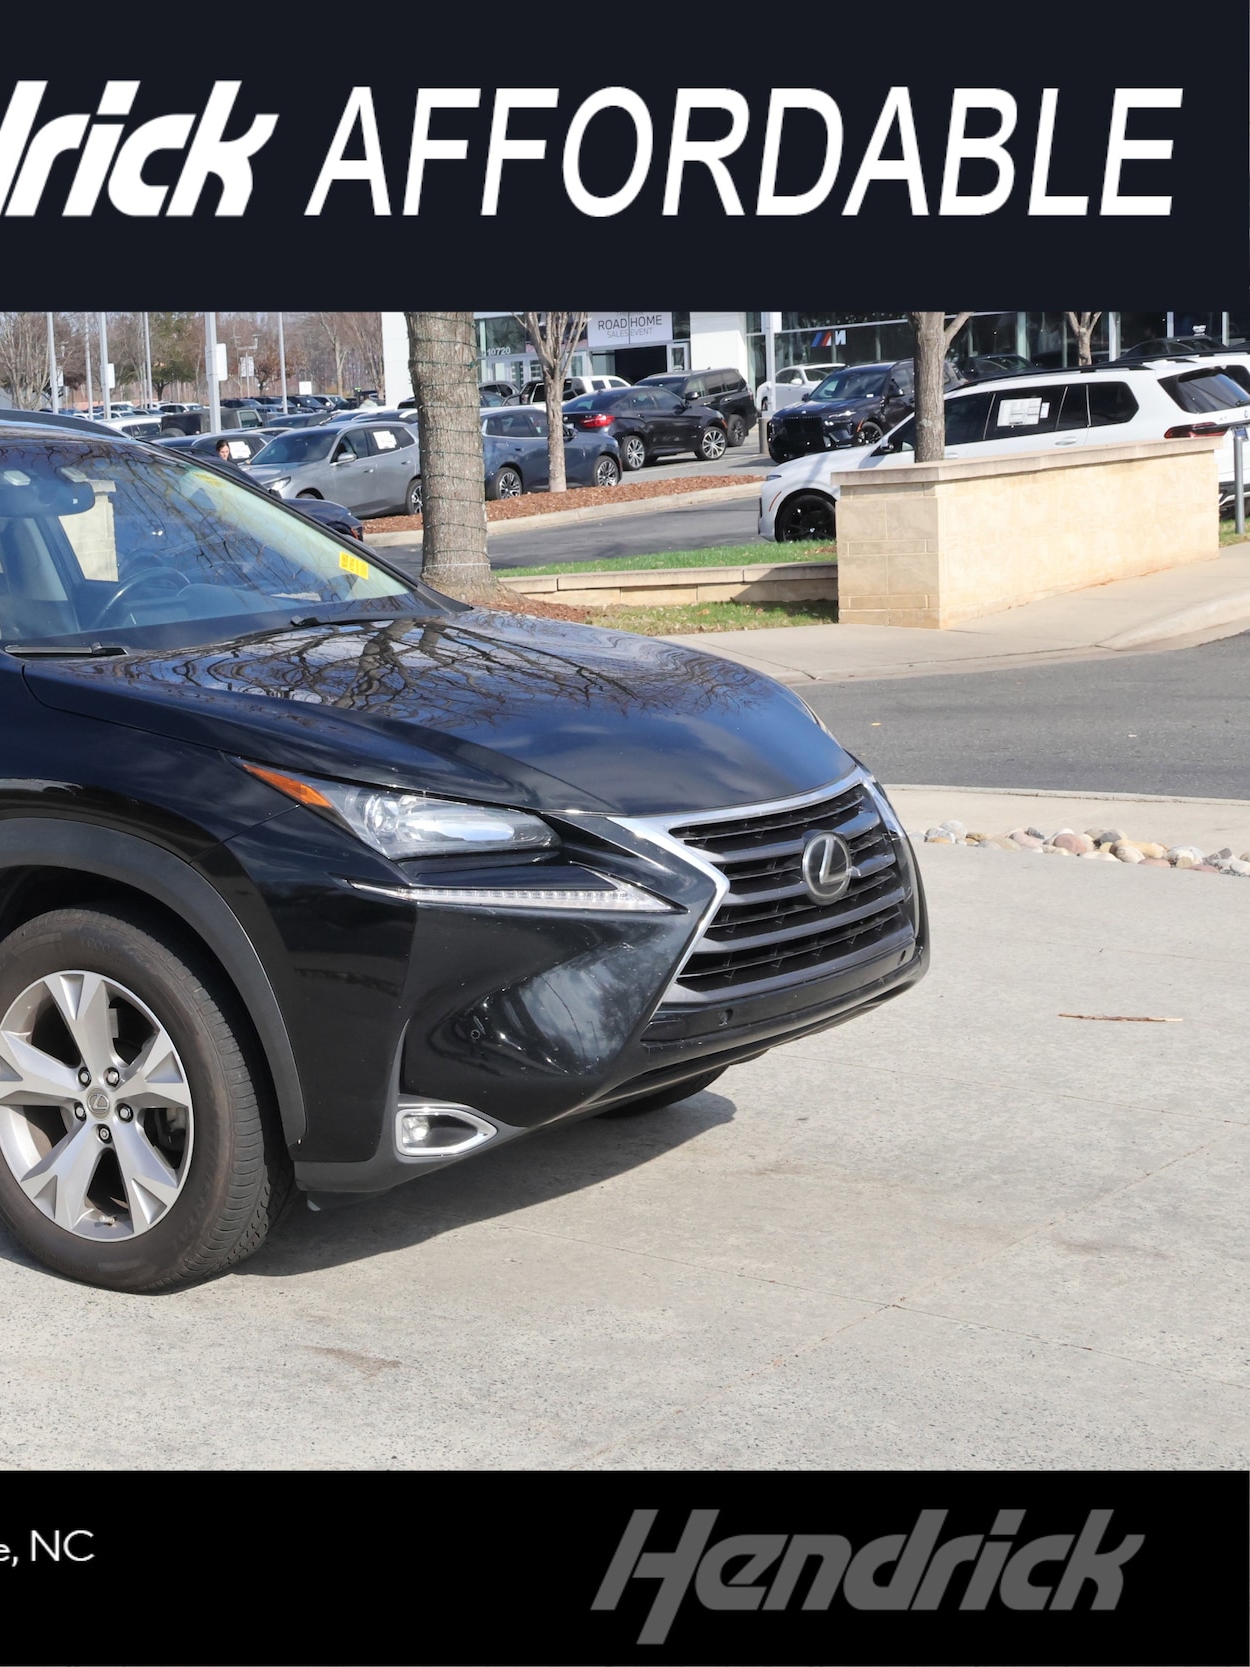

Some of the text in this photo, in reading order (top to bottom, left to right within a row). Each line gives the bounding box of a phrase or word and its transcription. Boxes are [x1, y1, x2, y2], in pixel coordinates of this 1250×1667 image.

[598, 315, 662, 330] ROAD HOME
[607, 328, 653, 338] SALES EVENT
[487, 346, 510, 355] 10720
